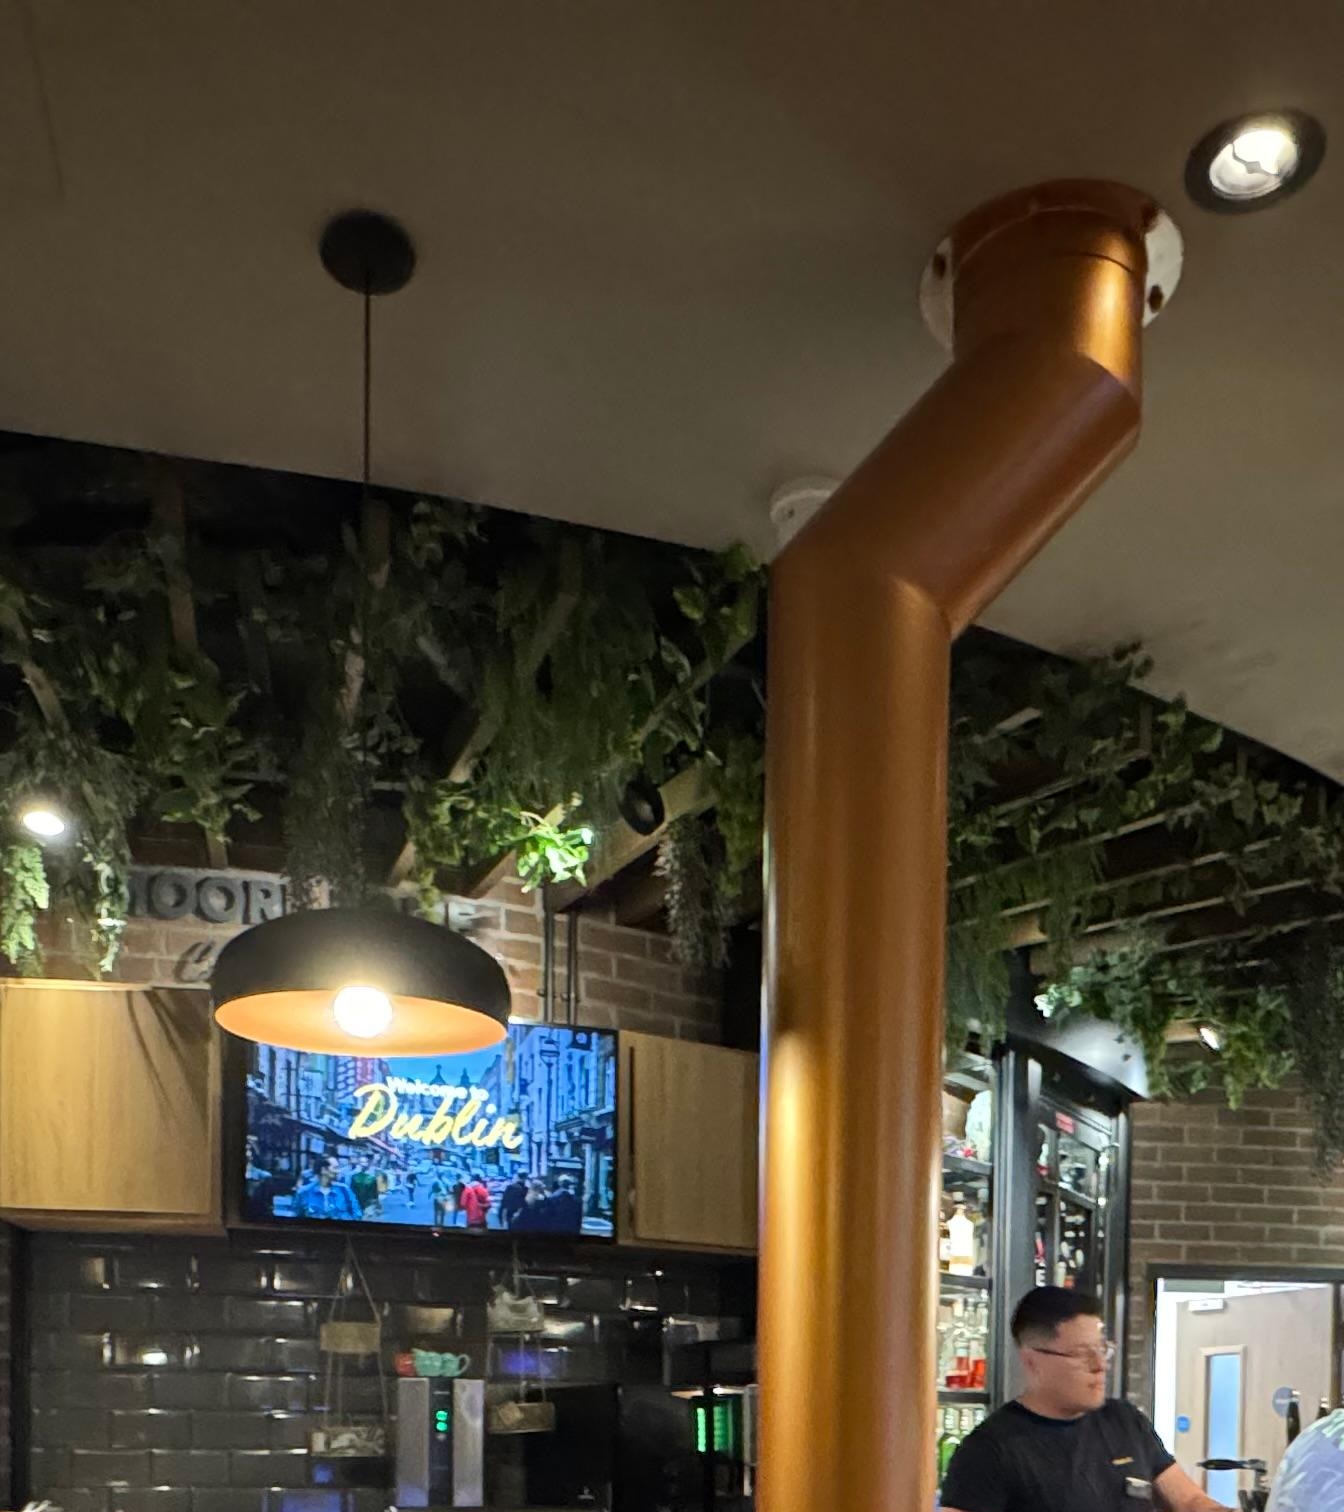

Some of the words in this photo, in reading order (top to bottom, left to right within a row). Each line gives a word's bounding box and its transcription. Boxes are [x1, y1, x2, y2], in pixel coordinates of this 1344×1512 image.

[386, 1076, 468, 1100] Welcome
[469, 1084, 489, 1102] to
[348, 1083, 523, 1149] Dublin
